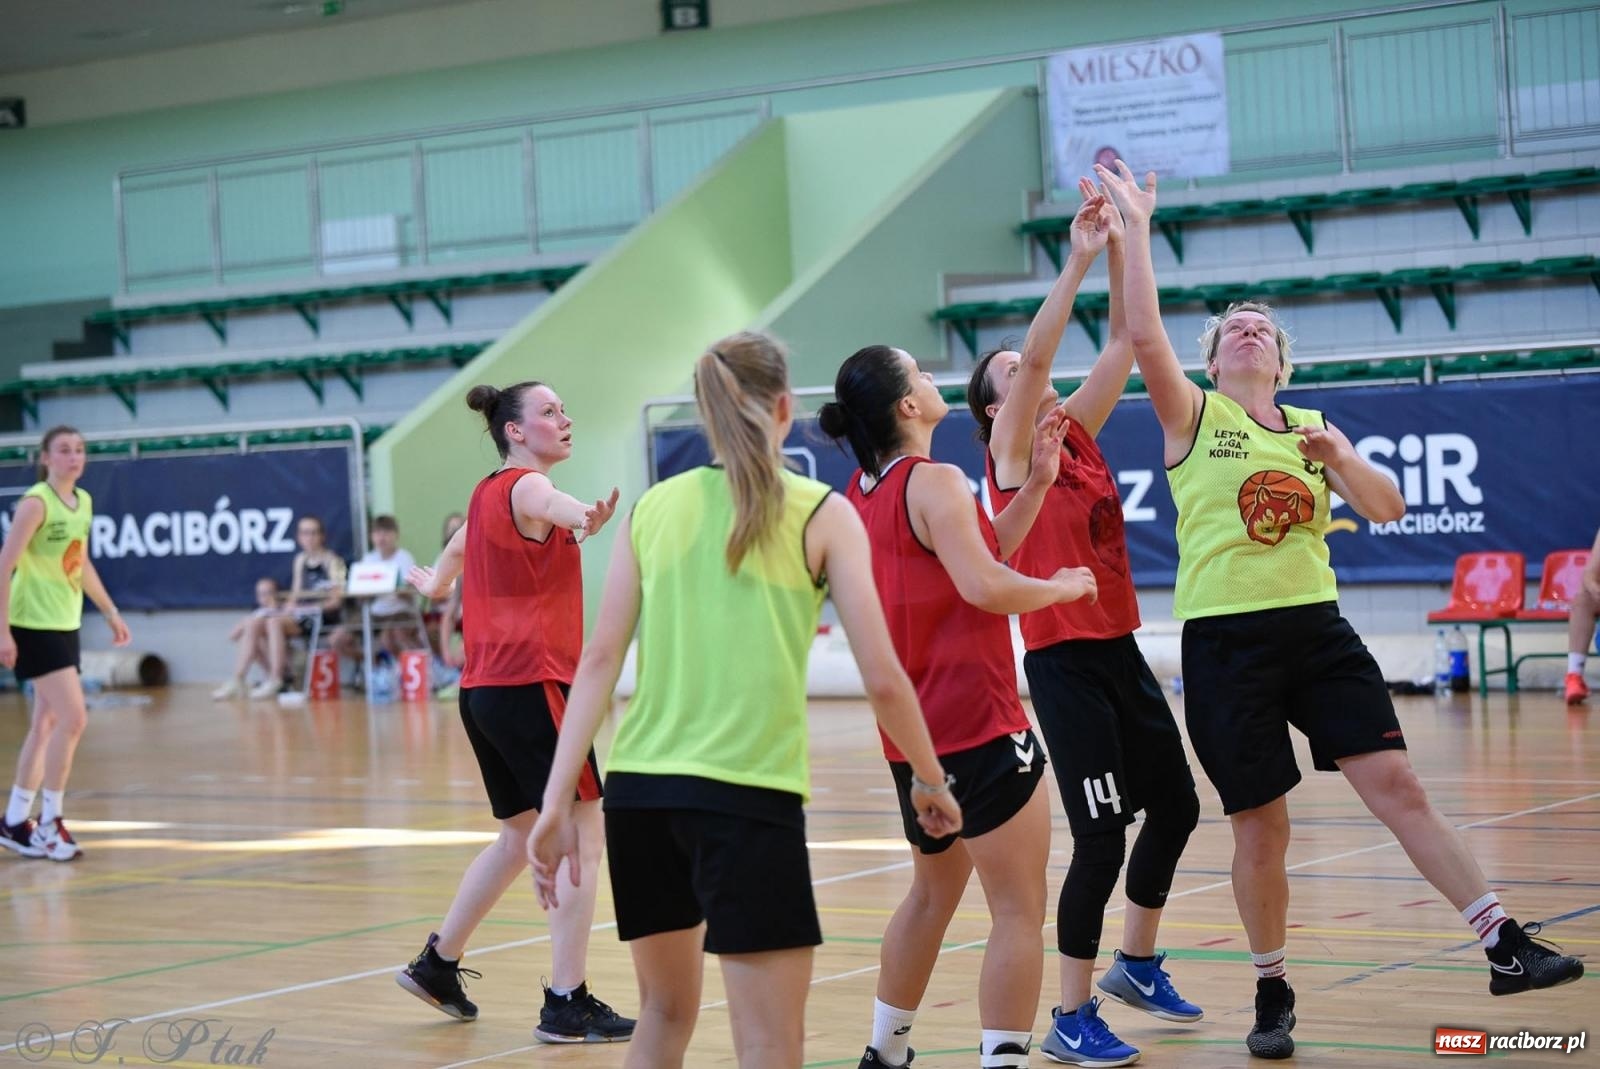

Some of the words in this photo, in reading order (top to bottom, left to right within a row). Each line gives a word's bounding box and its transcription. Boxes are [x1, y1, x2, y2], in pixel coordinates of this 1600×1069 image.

[1067, 43, 1202, 85] MIESZKO
[1209, 448, 1250, 460] KOBIET
[1217, 438, 1242, 450] LIGA
[1330, 433, 1484, 510] SiR
[91, 495, 296, 558] RACIBÓRZ
[316, 655, 333, 689] 5
[404, 655, 421, 691] 5
[1083, 772, 1121, 819] 14
